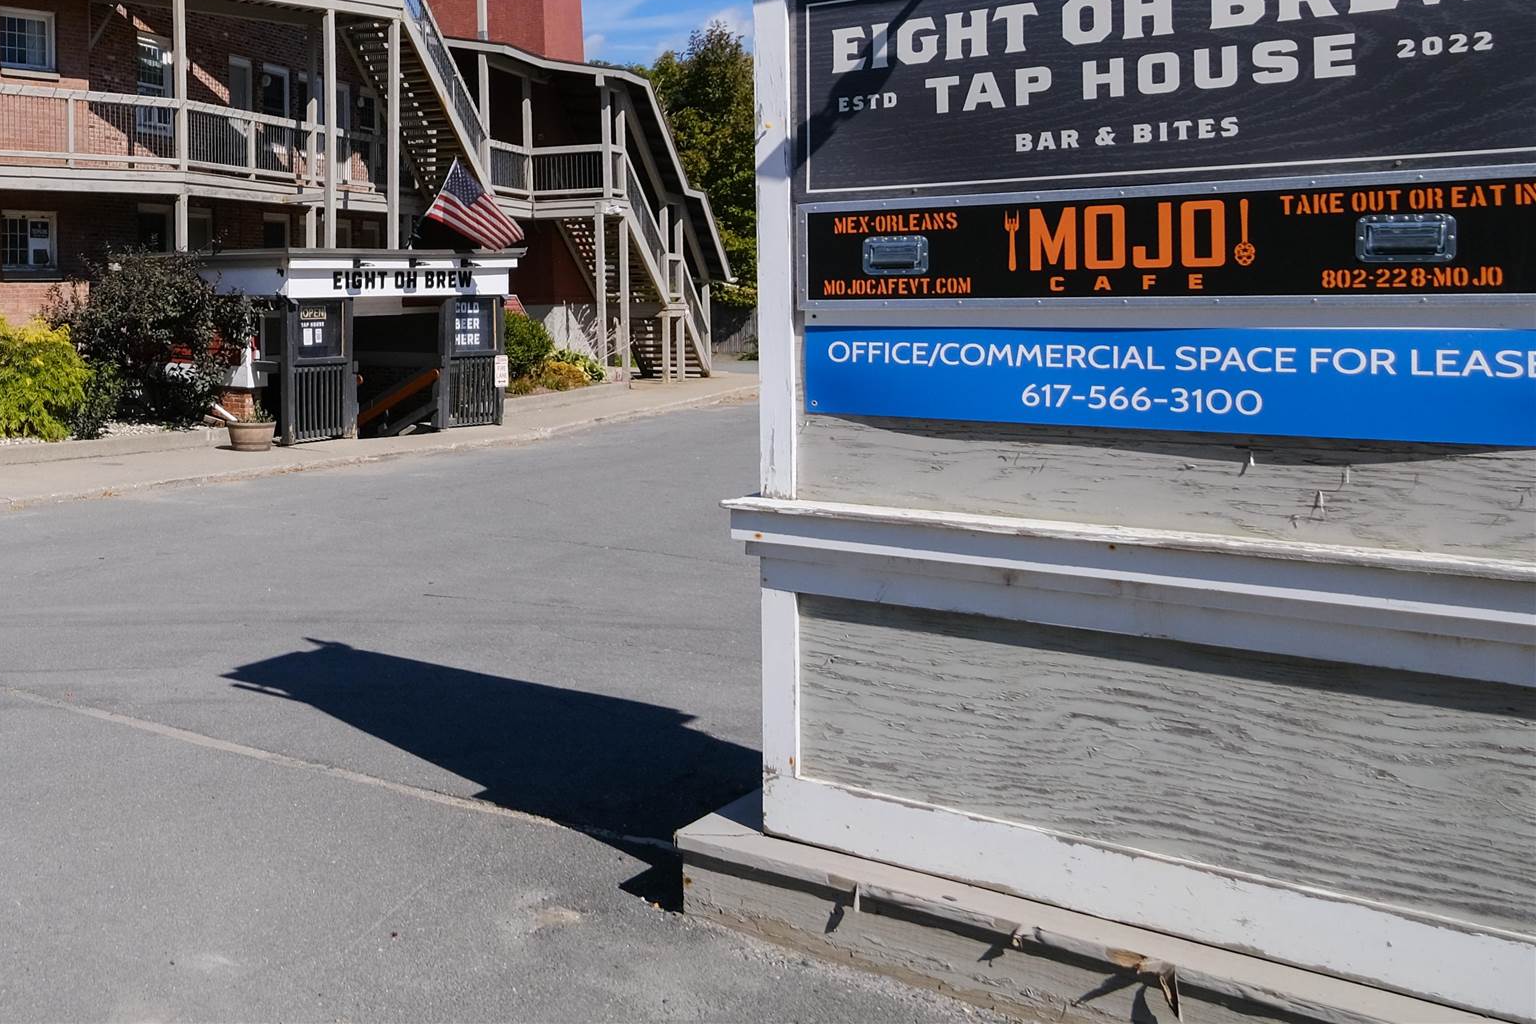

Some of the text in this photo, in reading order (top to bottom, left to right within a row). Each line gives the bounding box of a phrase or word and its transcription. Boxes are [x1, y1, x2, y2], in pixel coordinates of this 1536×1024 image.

[832, 2, 1039, 74] EIGHT
[1396, 31, 1494, 58] 2022
[925, 33, 1356, 113] TAP HOUSE
[838, 92, 897, 113] ESTD
[1015, 116, 1239, 152] BAR & BITES
[1279, 192, 1344, 215] TAKE
[1351, 189, 1402, 212] OUT
[1409, 187, 1444, 209] OR
[1451, 184, 1506, 208] EAT
[333, 270, 473, 290] EIGHT OH BREW
[824, 277, 971, 295] MOJOCAFEVT.COM
[1049, 273, 1204, 291] CAFE
[1321, 266, 1504, 289] 802-228-MOJO
[302, 308, 324, 318] OPEN
[456, 302, 480, 314] COLD
[455, 318, 480, 330] BEER
[455, 333, 480, 345] HERE
[828, 341, 1165, 371] OFFICE/COMMERCIAL
[1175, 346, 1297, 373] SPACE
[1310, 347, 1397, 375] FOR
[1021, 384, 1262, 416] 617-566-3100
